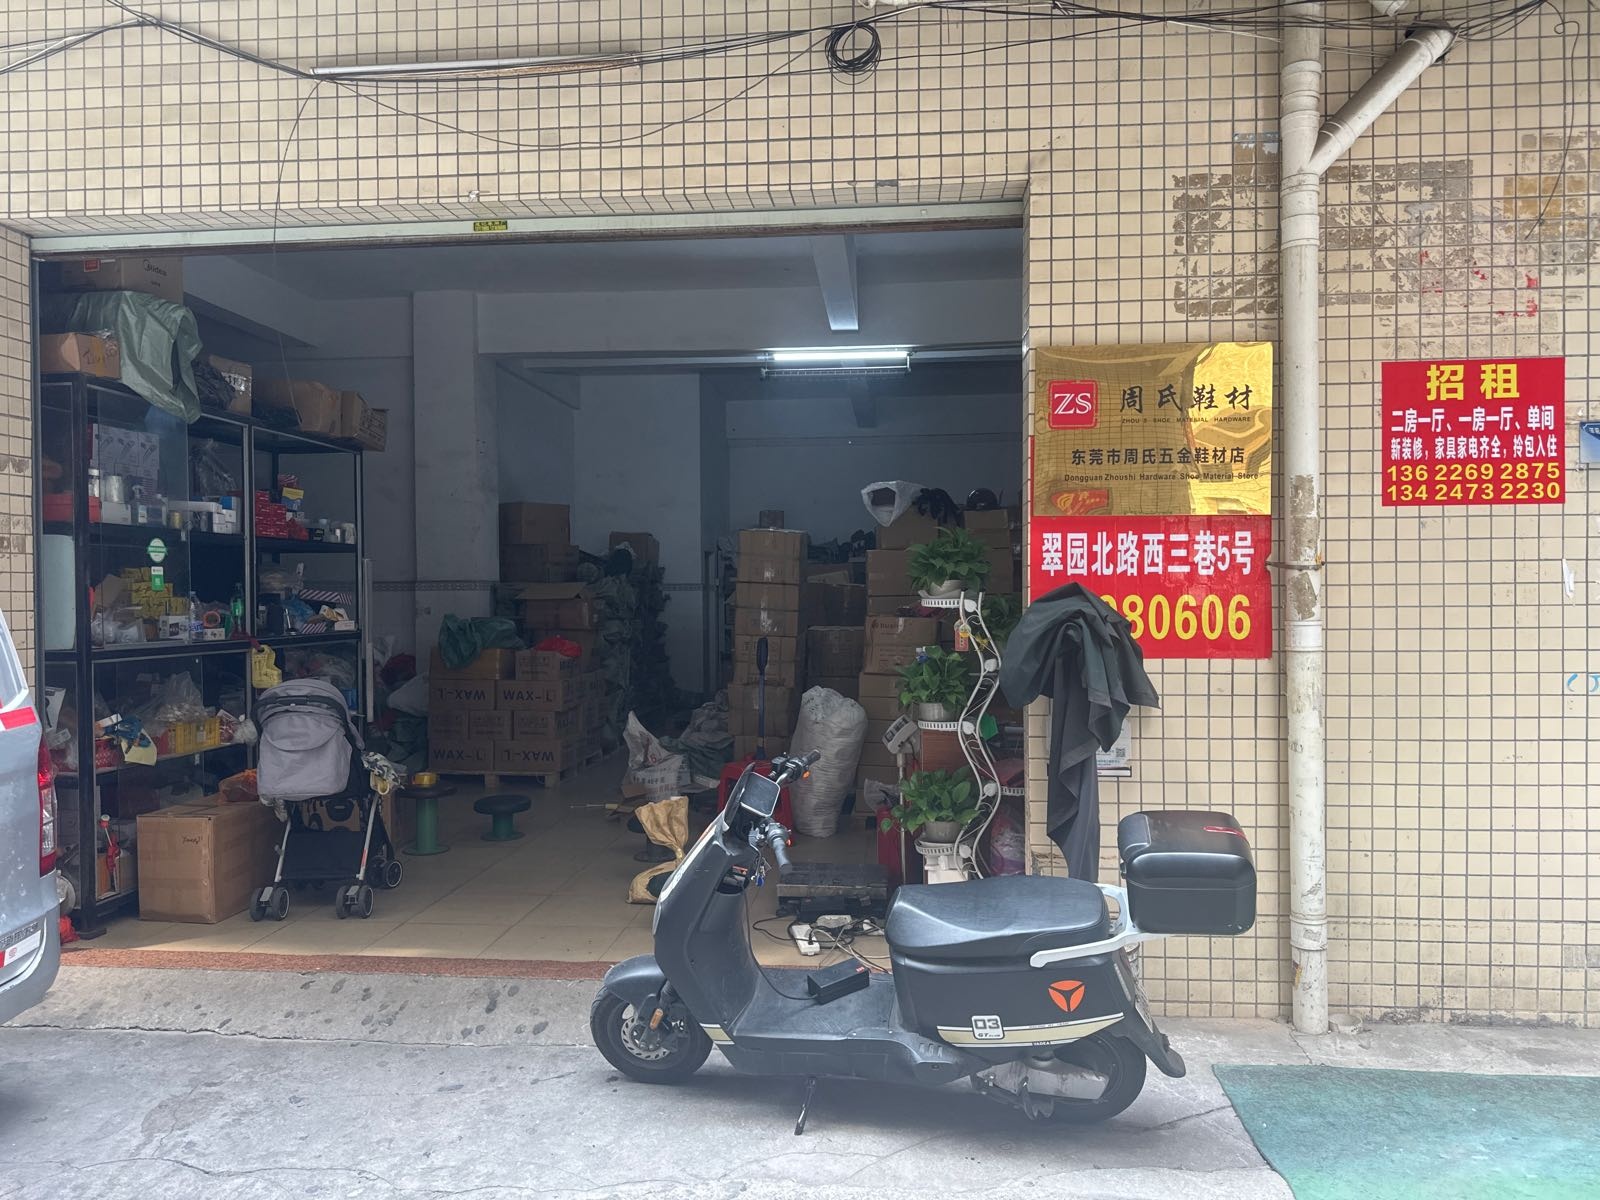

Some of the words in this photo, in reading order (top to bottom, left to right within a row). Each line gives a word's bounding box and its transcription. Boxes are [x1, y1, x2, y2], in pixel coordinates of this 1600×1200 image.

[1426, 364, 1520, 401] 招租
[1054, 393, 1092, 415] ZS
[1120, 384, 1252, 413] 周氏鞋材
[1391, 405, 1554, 433] 二房一厅、一房一厅、单间
[1071, 447, 1245, 466] 东莞市周氏五金鞋材店
[1064, 473, 1103, 483] Dongguan
[1104, 473, 1136, 481] Zhoushi
[1139, 473, 1176, 481] Hardware
[1203, 472, 1234, 480] Material
[1237, 472, 1259, 480] Store
[1387, 465, 1429, 482] 136
[1434, 463, 1494, 481] 2269
[1500, 462, 1560, 480] 2875
[1387, 484, 1429, 501] 134
[1434, 483, 1494, 501] 2473
[1500, 482, 1560, 499] 2230
[1041, 530, 1255, 577] 翠园北路西三巷5号
